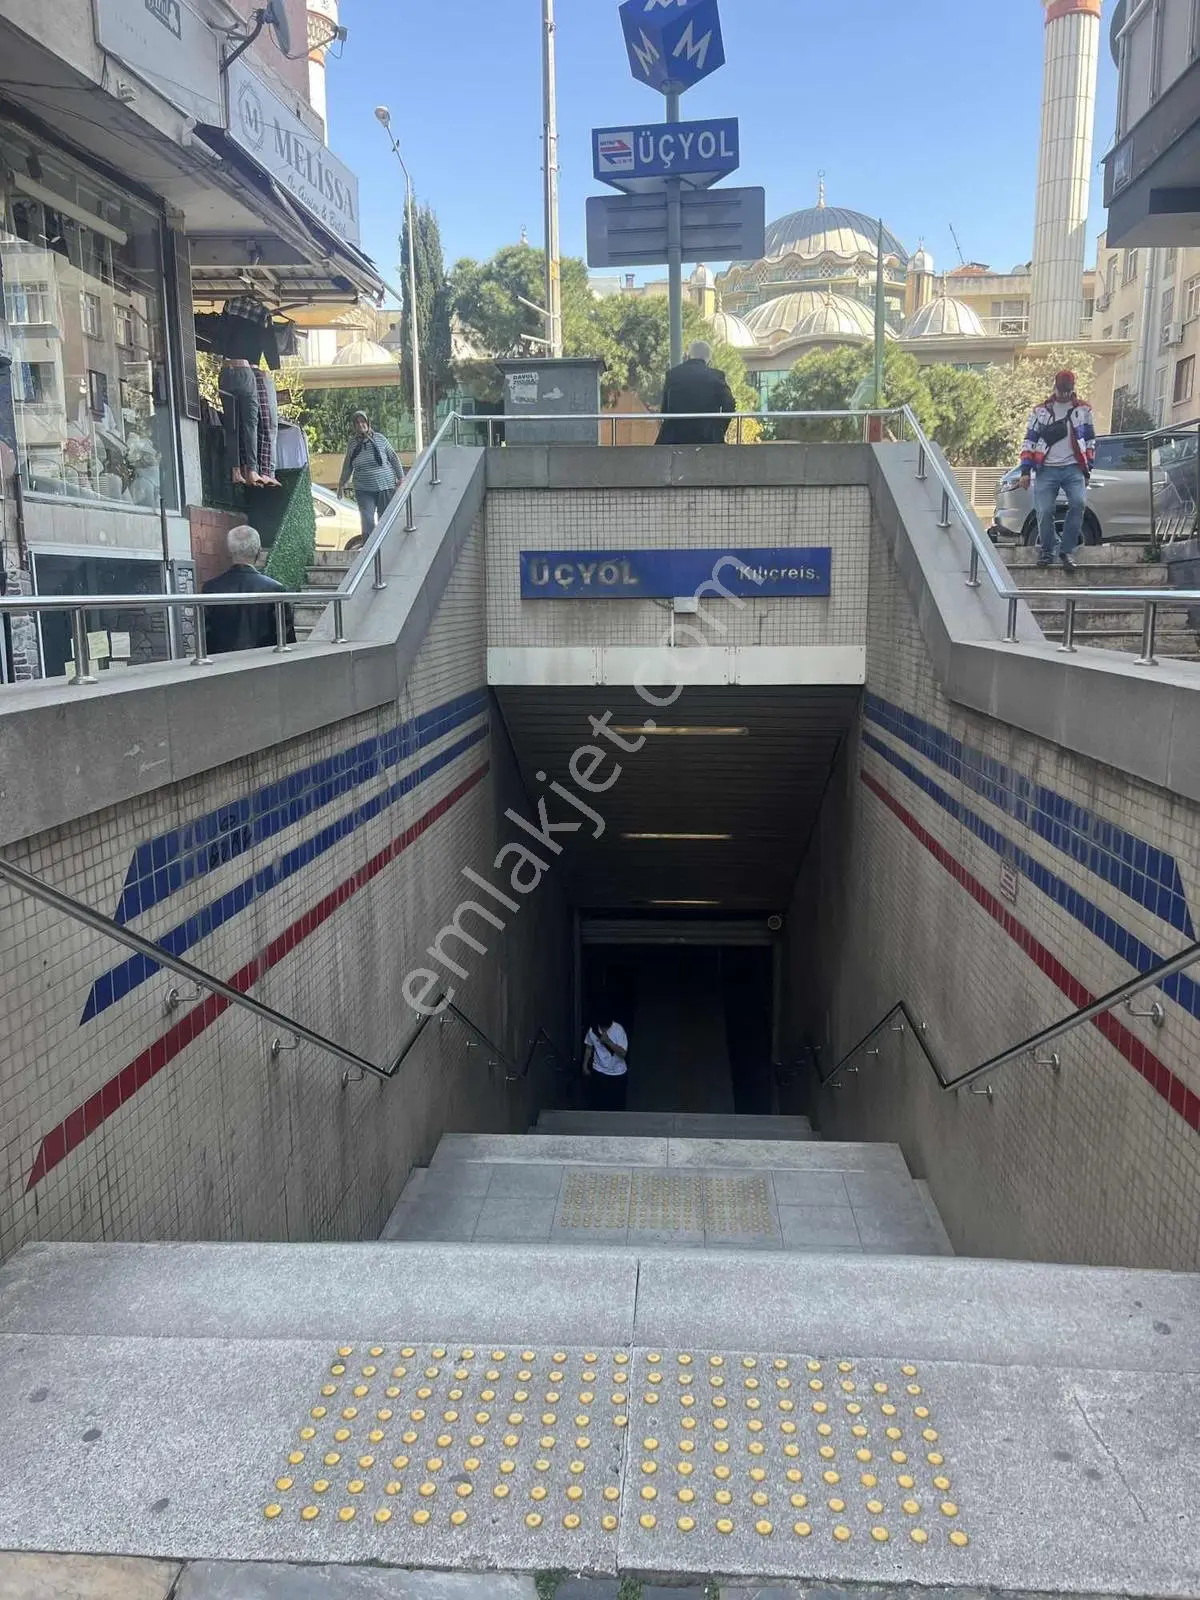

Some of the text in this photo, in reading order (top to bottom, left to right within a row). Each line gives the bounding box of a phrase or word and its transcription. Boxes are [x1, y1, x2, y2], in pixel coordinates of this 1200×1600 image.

[672, 20, 712, 69] M
[274, 116, 355, 222] MELİSSA
[639, 131, 734, 169] ÜÇYOL
[531, 557, 639, 590] ÜÇYOL
